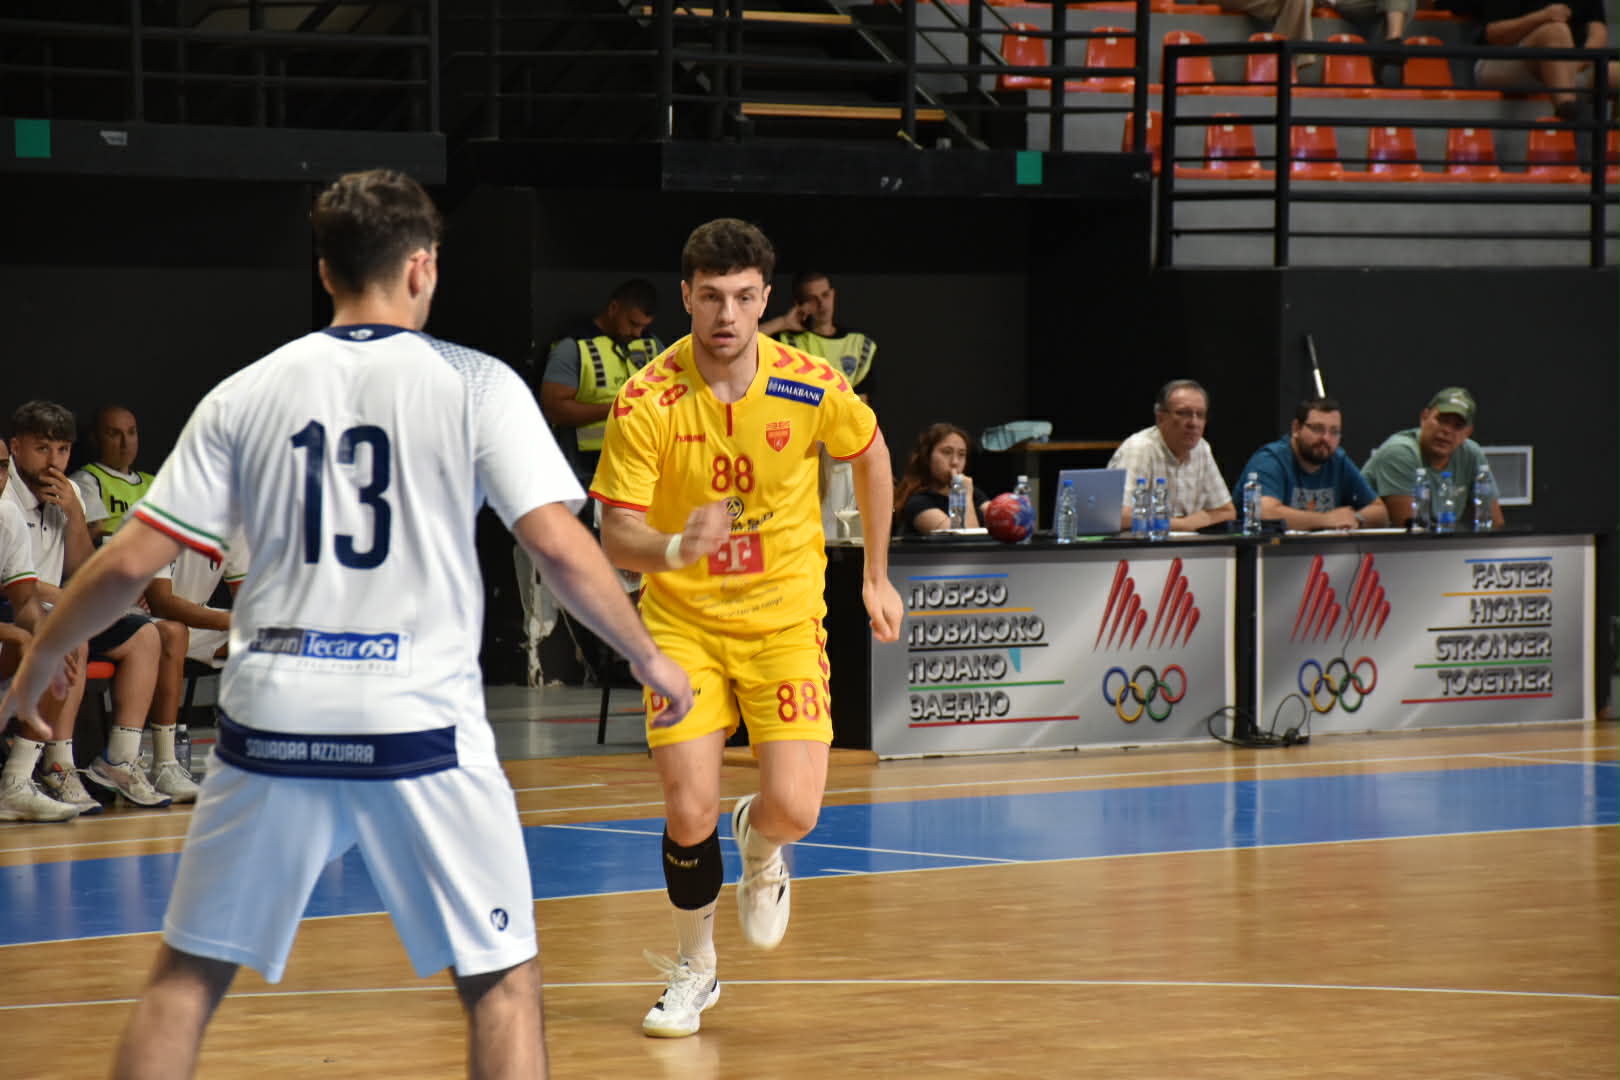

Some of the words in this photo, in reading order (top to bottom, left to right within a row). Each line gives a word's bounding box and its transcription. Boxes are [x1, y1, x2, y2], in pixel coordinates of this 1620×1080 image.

[776, 383, 821, 402] HALKBANK
[711, 454, 755, 494] 88
[290, 419, 391, 571] 13
[1472, 562, 1553, 589] FASTER
[908, 583, 1008, 609] ПОБРЗО
[1470, 596, 1553, 624] HIGHER
[306, 631, 358, 658] Tecar
[908, 615, 1045, 646] ПОВИСОКО
[1436, 632, 1553, 662] STRONGER
[908, 654, 1007, 684] ПОЈАКО
[1437, 667, 1553, 696] TOGETHER
[777, 682, 821, 723] 88
[908, 690, 1010, 723] ЗАЕДНО
[245, 738, 307, 761] SQUADRA
[310, 741, 375, 764] AZZURRA
